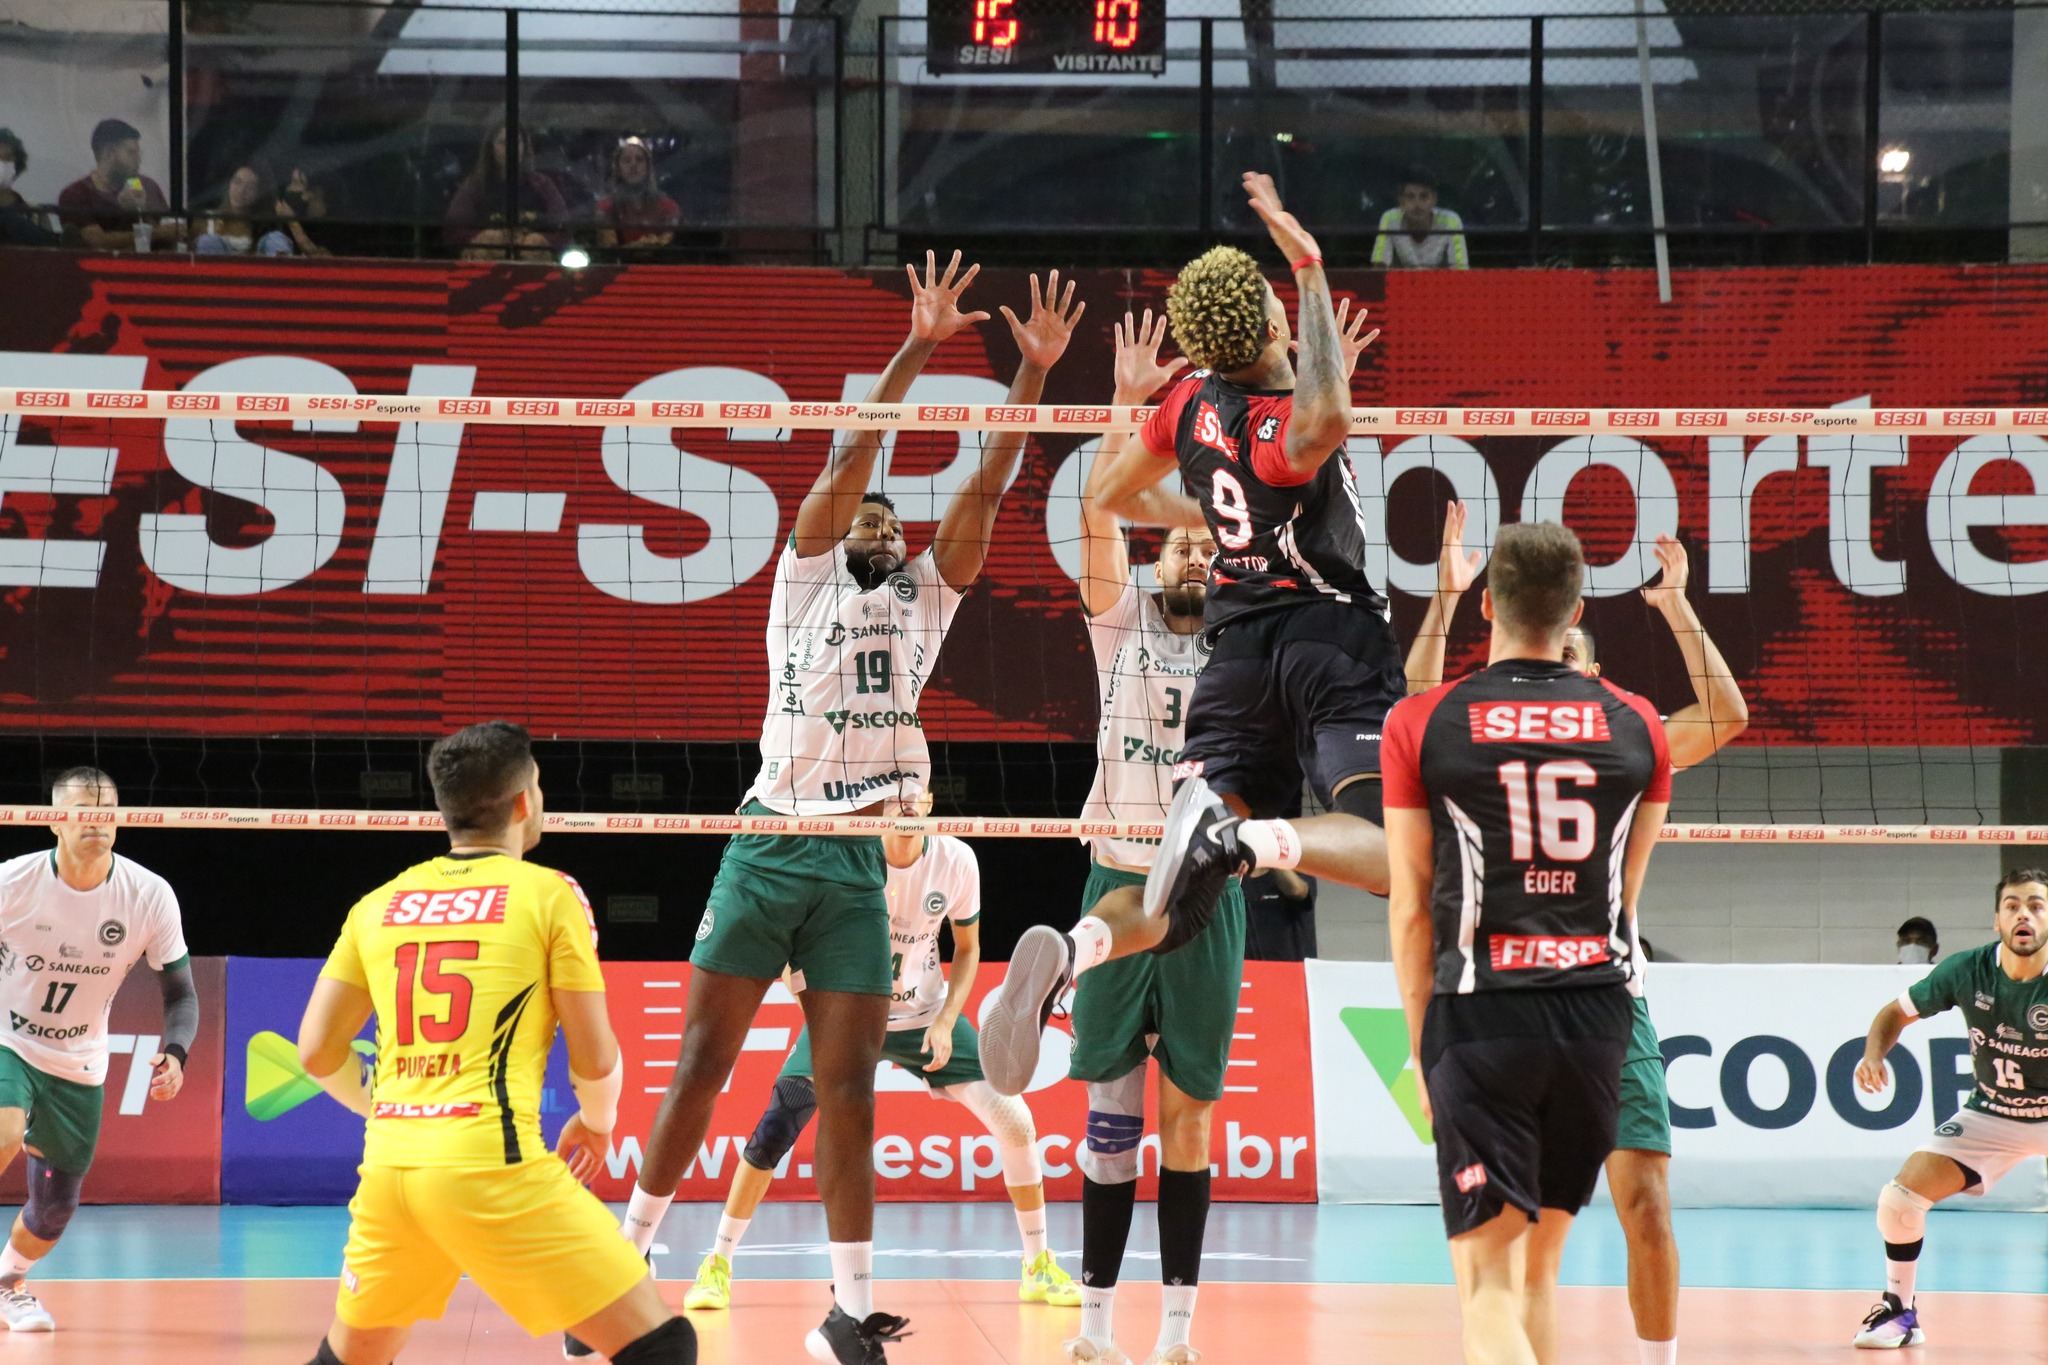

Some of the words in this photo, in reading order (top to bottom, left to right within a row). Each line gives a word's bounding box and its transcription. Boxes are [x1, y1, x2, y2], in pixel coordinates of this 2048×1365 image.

[974, 0, 1018, 47] 15
[1094, 0, 1138, 47] 10
[959, 46, 1012, 65] SESI
[1053, 55, 1163, 71] VISITANTE
[20, 392, 66, 407] SESI
[91, 394, 144, 408] FIESP
[171, 395, 216, 409] SESI
[241, 396, 286, 411] SESI
[307, 397, 378, 411] SESI-SP
[376, 403, 422, 415] esporte
[442, 400, 487, 414] SESI
[511, 401, 556, 415] SESI
[580, 402, 631, 416] FIESP
[656, 403, 700, 418] SESI
[724, 404, 768, 418] SESI
[788, 405, 858, 418] SESI-SP
[857, 410, 902, 422] esporte
[921, 407, 967, 421] SESI
[990, 408, 1033, 422] SESI
[1056, 408, 1108, 422] FIESP
[1400, 411, 1444, 425] SESI
[1467, 411, 1511, 425] SESI
[1535, 411, 1585, 426] FIESP
[1612, 412, 1656, 426] SESI
[1680, 412, 1724, 426] SESI
[1745, 411, 1815, 424] SESI-SP
[1813, 416, 1858, 427] esporte
[1878, 412, 1923, 426] SESI
[1947, 412, 1992, 425] SESI
[1211, 467, 1254, 550] 9
[851, 624, 903, 640] SANEA
[853, 650, 891, 695] 19
[1162, 687, 1182, 729] 3
[1483, 705, 1597, 740] SESI
[29, 811, 66, 821] FIESP
[81, 812, 114, 823] SESI
[130, 813, 163, 823] SESI
[274, 814, 307, 825] SESI
[322, 815, 355, 825] SESI
[370, 815, 408, 826] FIESP
[1497, 759, 1598, 862] 16
[609, 818, 642, 828] SESI
[655, 818, 689, 829] SESI
[702, 819, 741, 829] FIESP
[753, 820, 787, 831] SESI
[800, 821, 834, 832] SESI
[940, 822, 972, 833] SESI
[987, 823, 1019, 833] SESI
[1033, 823, 1070, 834] FIESP
[1083, 824, 1117, 834] SESI
[1131, 825, 1164, 835] SESI
[1693, 829, 1729, 838] FIESP
[1743, 829, 1775, 839] SESI
[1790, 830, 1822, 839] SESI
[1932, 830, 1965, 840] SESI
[1981, 831, 2013, 840] SESI
[1523, 863, 1577, 894] ÉDER
[393, 888, 498, 925] SESI
[48, 961, 111, 976] SANEAGO
[1501, 939, 1602, 969] FIESP
[40, 981, 78, 1014] 17
[394, 940, 480, 1047] 15
[26, 1023, 89, 1040] SICOOB
[396, 1053, 461, 1081] PUREZA
[1992, 1058, 2026, 1091] 15
